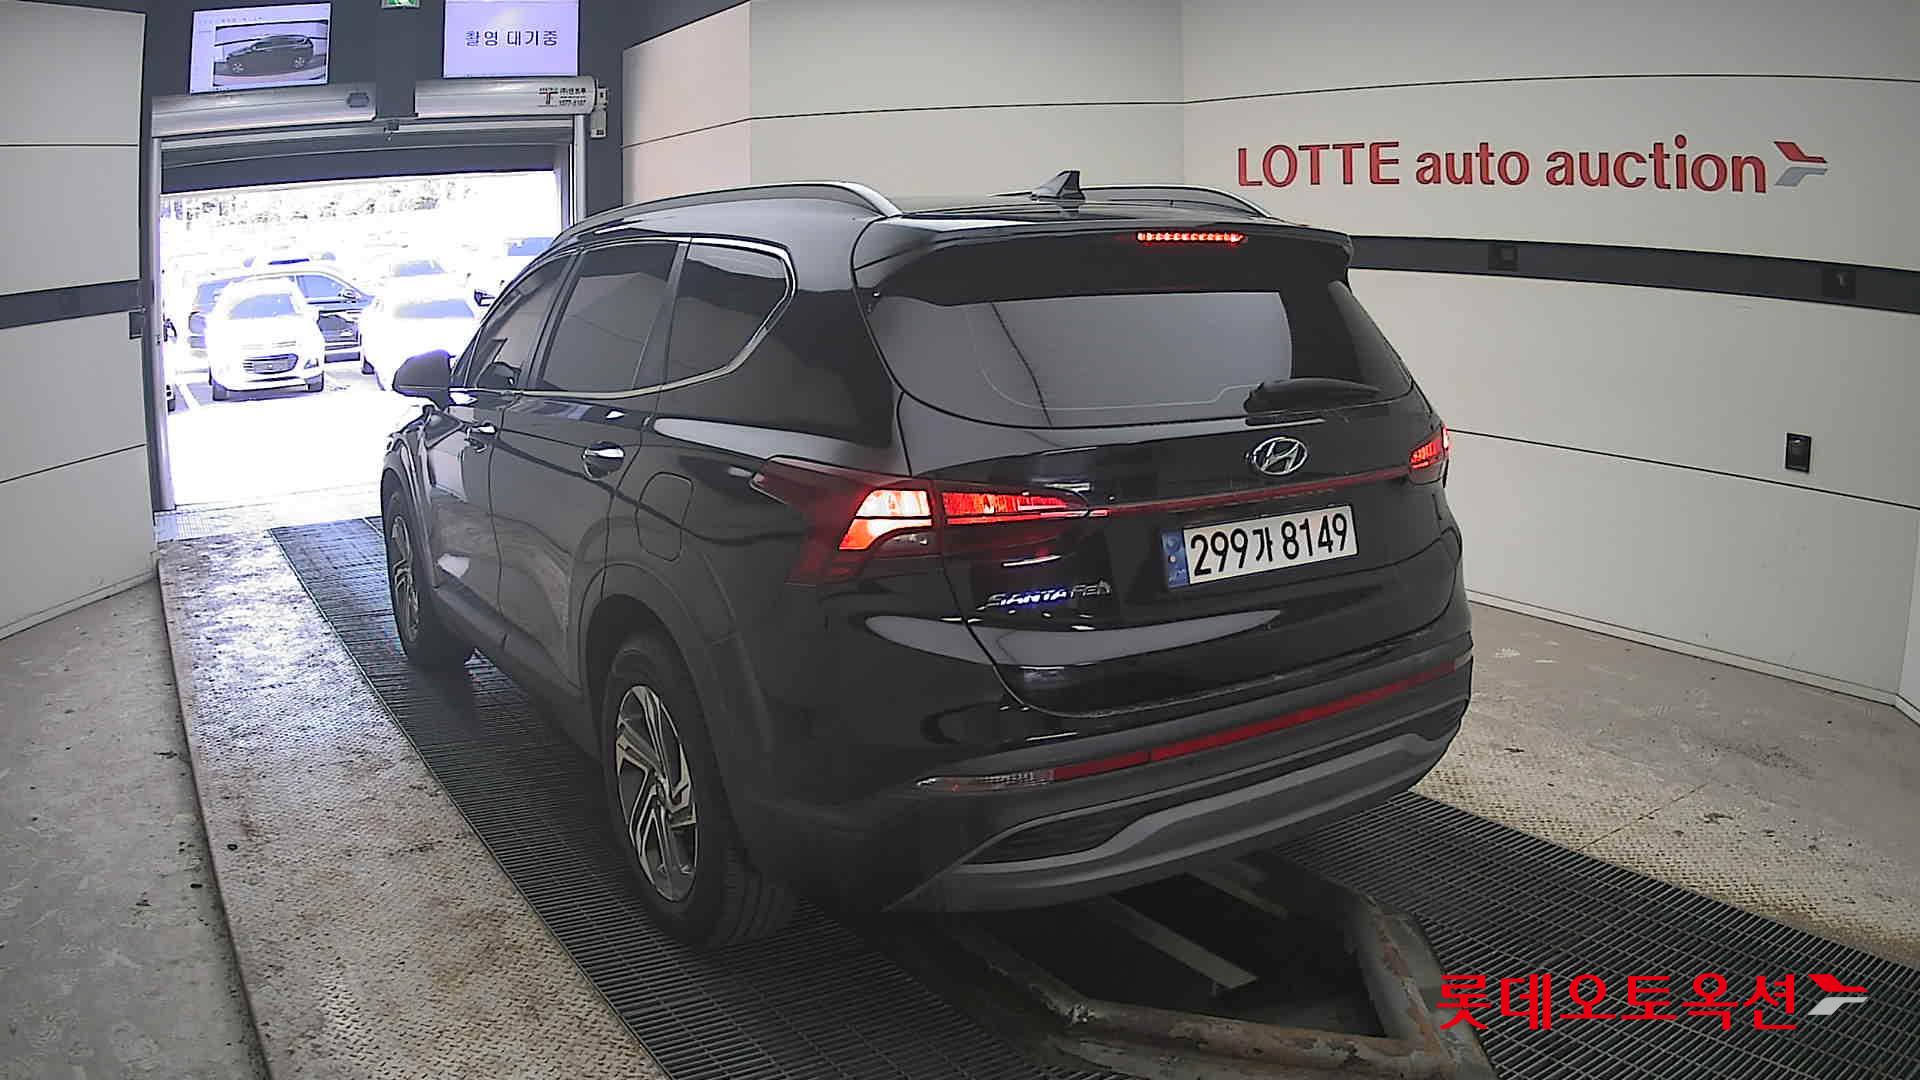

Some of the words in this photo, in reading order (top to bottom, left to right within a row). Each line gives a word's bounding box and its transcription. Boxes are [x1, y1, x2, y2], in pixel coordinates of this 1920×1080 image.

[506, 30, 557, 47] 대기중
[1237, 141, 1400, 188] LOTTE
[1415, 140, 1530, 187] auto
[1545, 134, 1768, 194] auction
[1190, 526, 1273, 577] 299가
[1280, 512, 1348, 560] 8149
